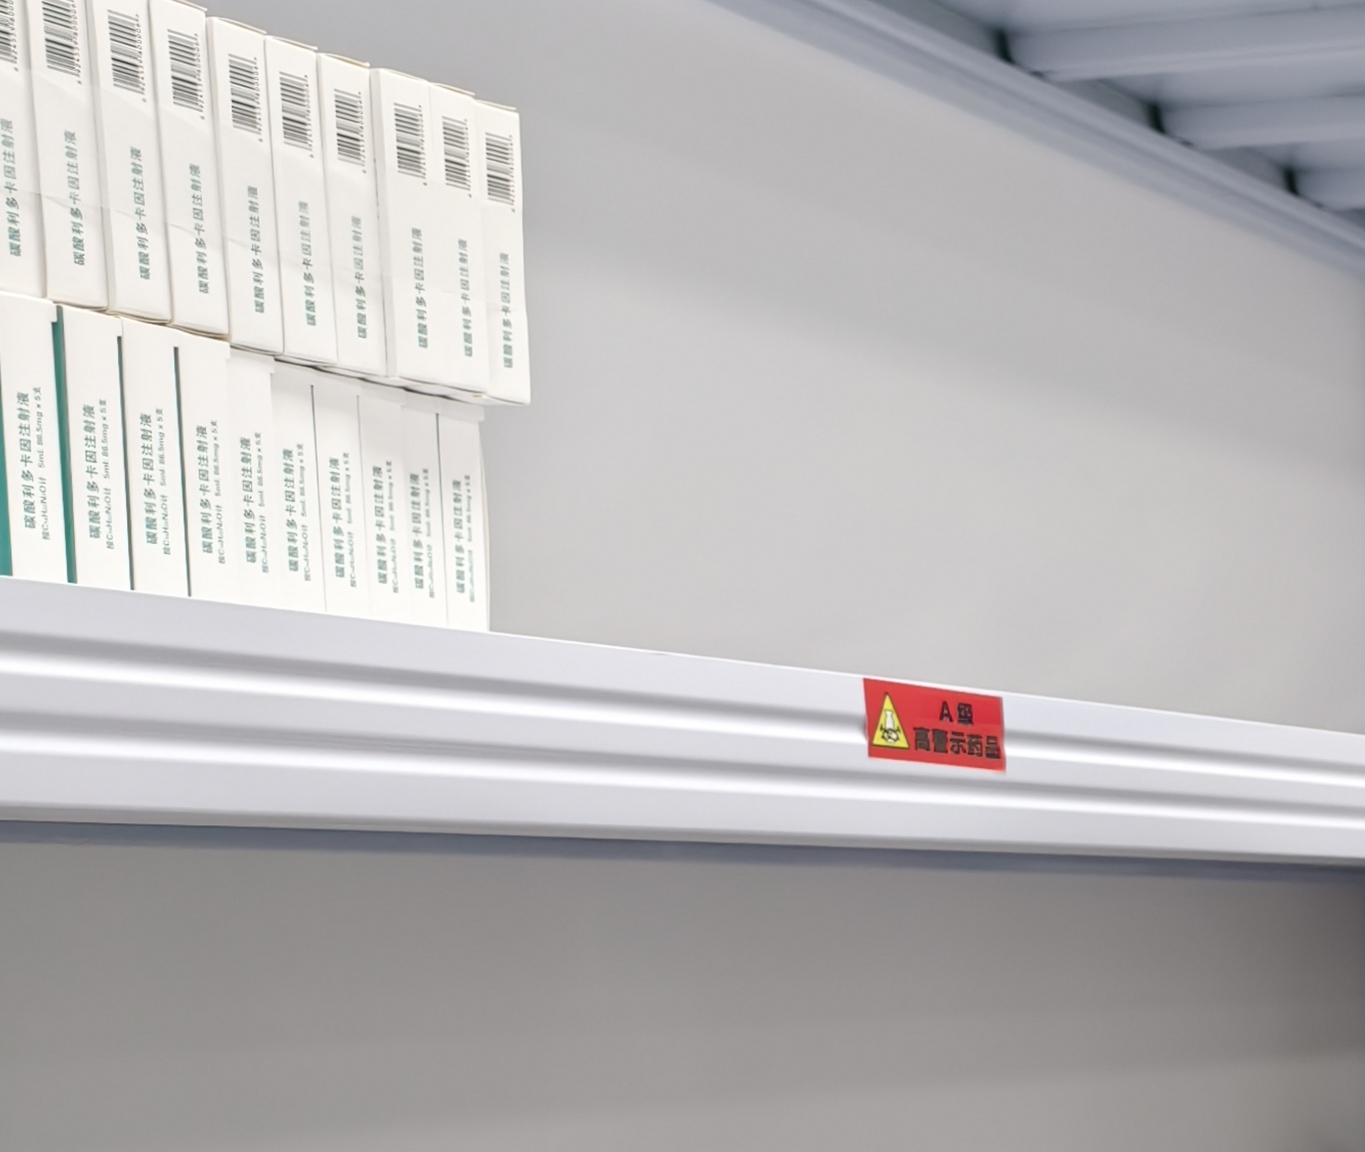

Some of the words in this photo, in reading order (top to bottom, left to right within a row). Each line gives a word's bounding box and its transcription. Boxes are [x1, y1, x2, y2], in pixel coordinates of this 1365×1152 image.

[913, 727, 1001, 760] 高警示药品
